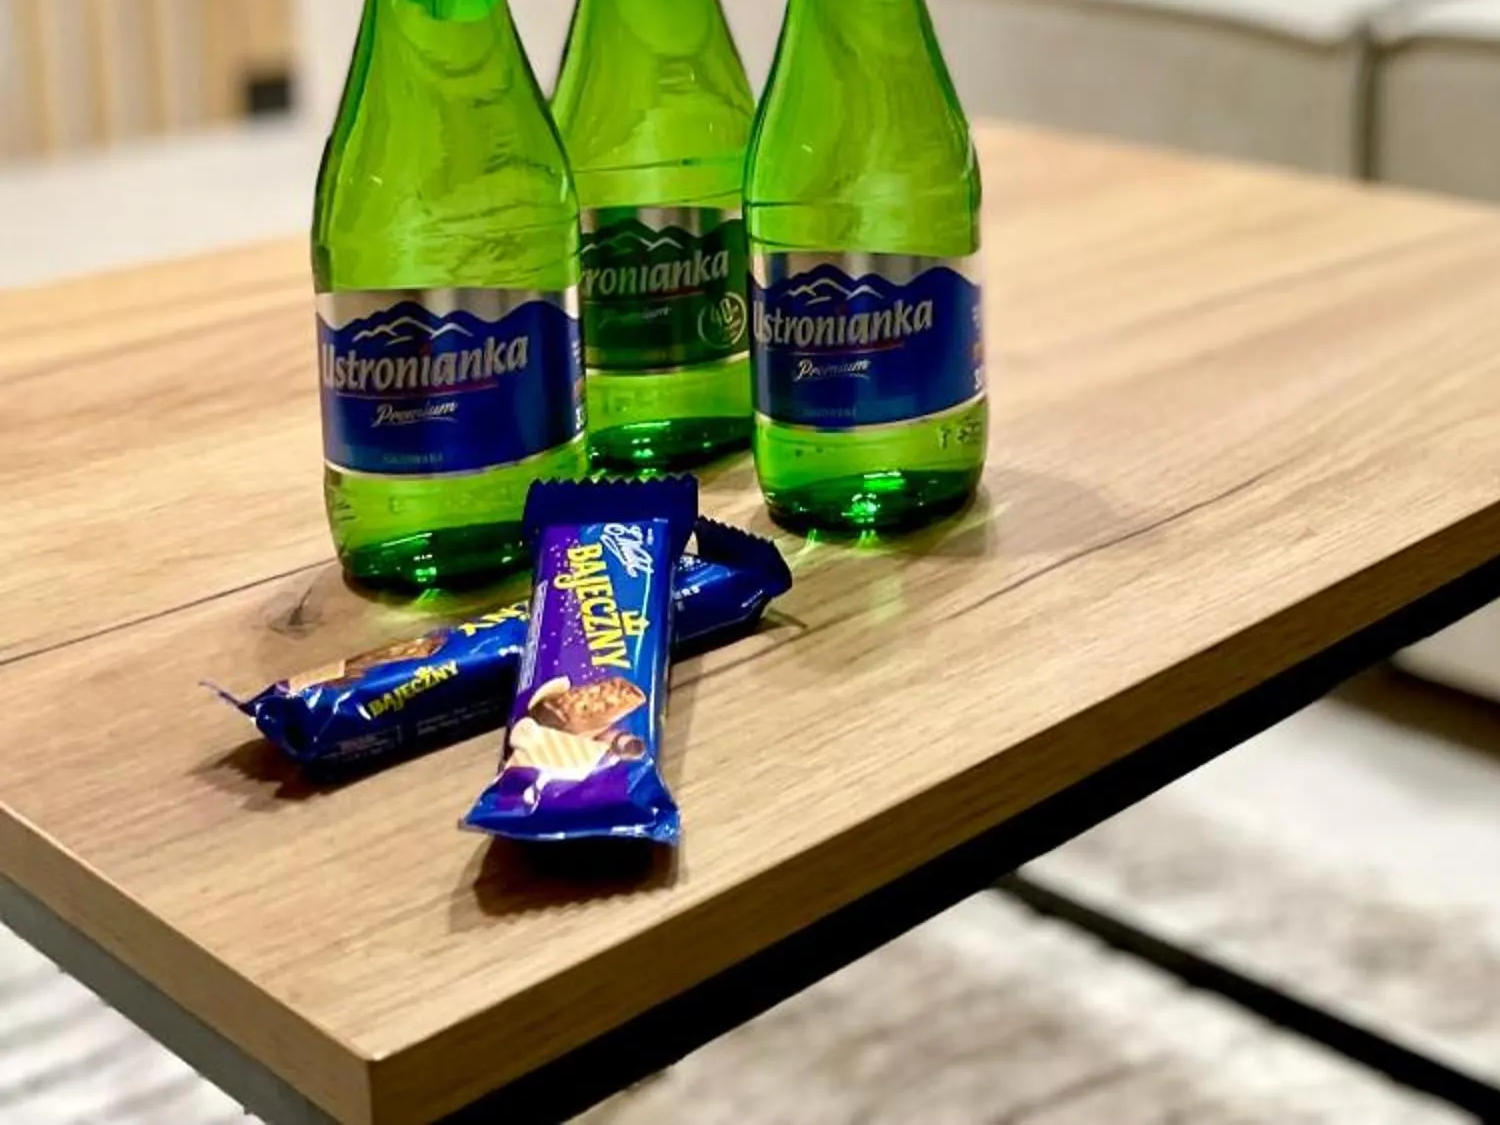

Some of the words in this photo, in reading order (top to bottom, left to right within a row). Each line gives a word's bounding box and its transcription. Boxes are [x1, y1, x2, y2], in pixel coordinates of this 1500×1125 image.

[582, 249, 729, 296] ronianka
[753, 299, 933, 347] Ustronianka
[321, 335, 529, 392] Ustronianka
[371, 401, 458, 428] Premium
[554, 543, 631, 668] BAJECZNY
[369, 660, 459, 717] BAJECZNY
